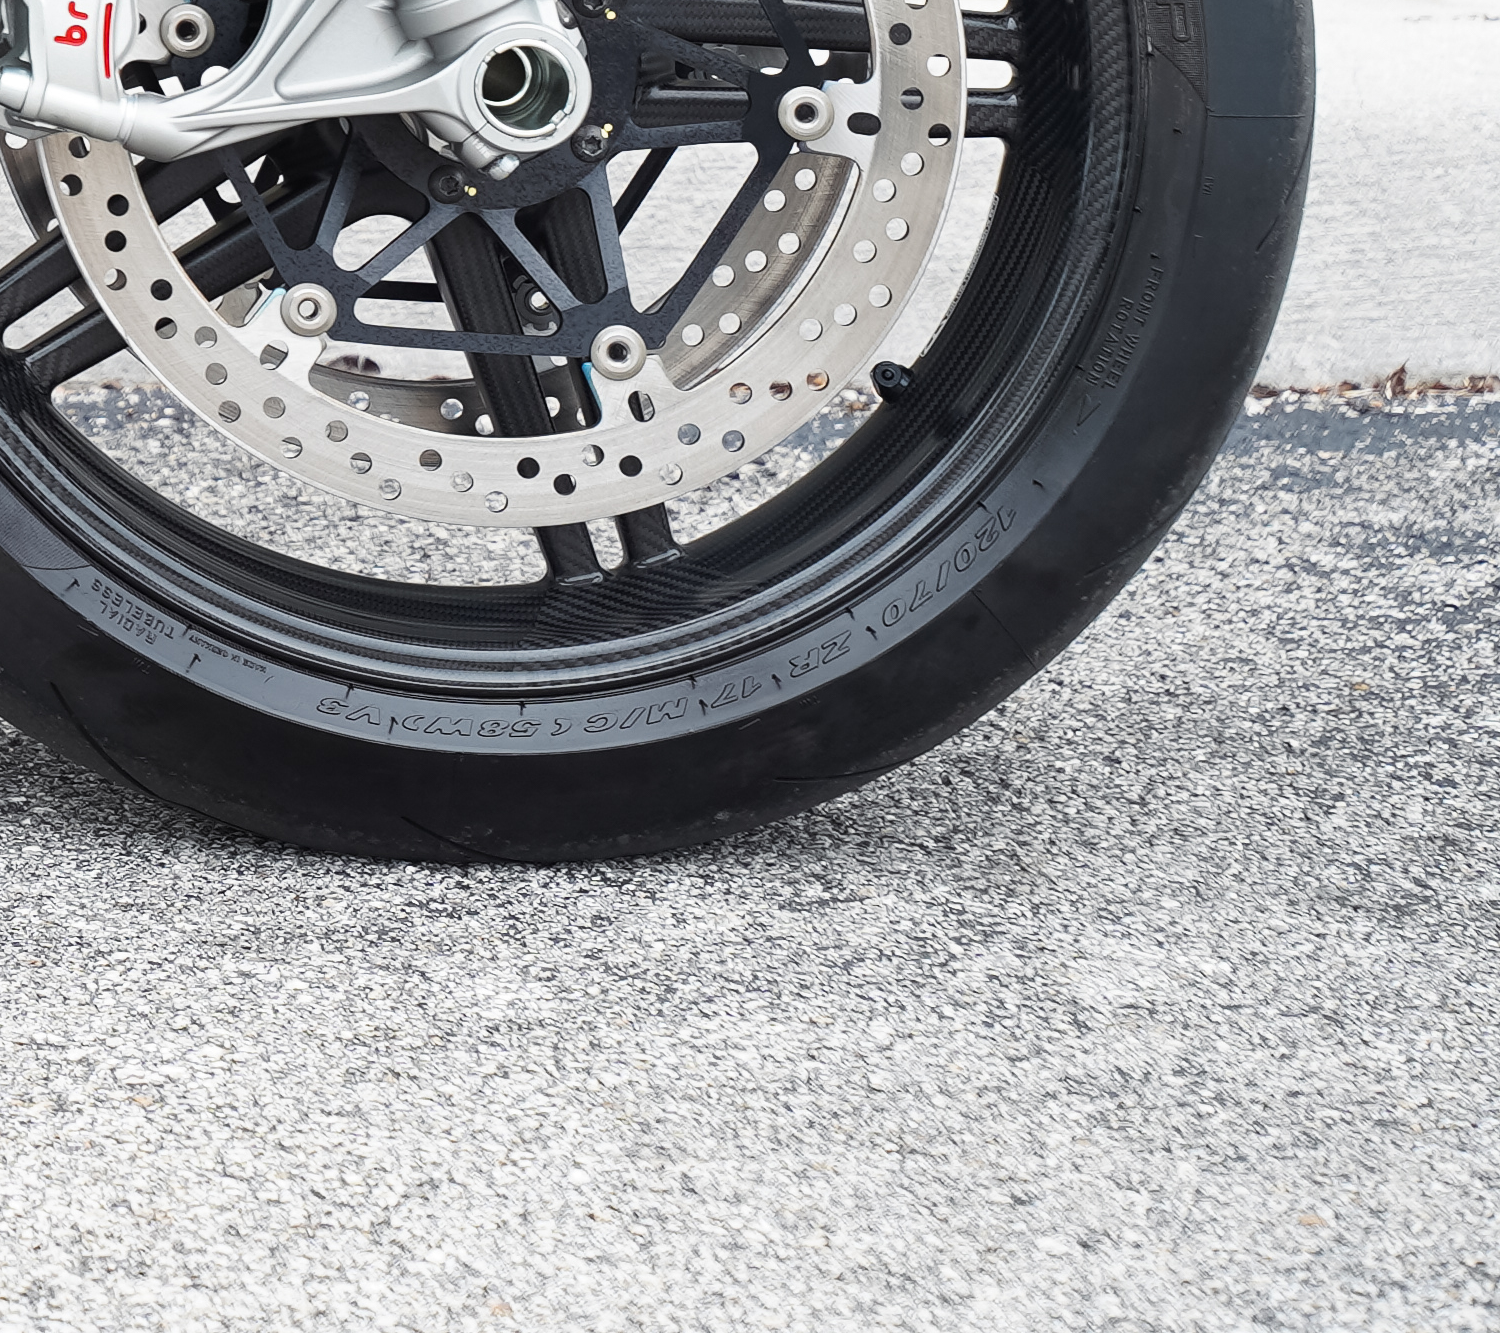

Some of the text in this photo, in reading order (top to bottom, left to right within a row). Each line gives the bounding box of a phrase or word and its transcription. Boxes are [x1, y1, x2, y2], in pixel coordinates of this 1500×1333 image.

[872, 498, 1022, 634] 120/70
[84, 573, 180, 643] TUBELESS
[91, 596, 161, 648] RADIAL
[781, 625, 859, 684] ZR
[701, 670, 765, 712] 17
